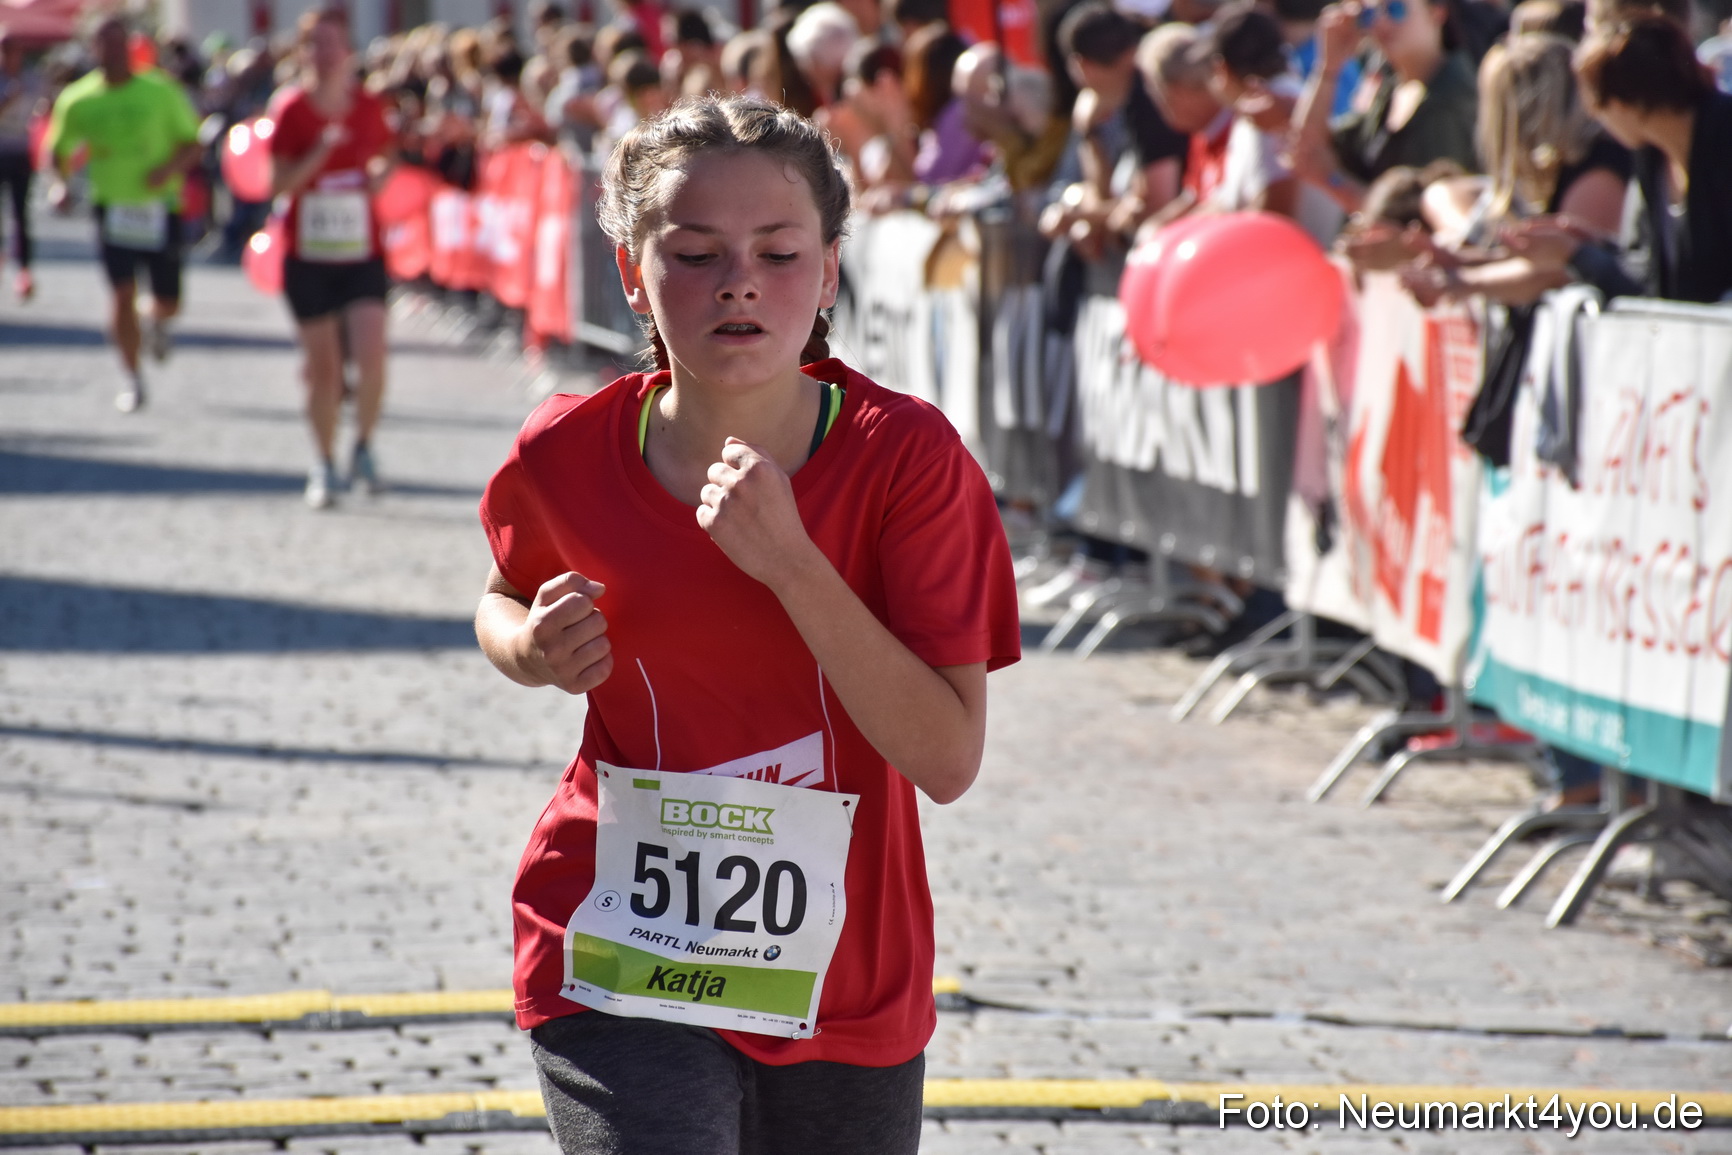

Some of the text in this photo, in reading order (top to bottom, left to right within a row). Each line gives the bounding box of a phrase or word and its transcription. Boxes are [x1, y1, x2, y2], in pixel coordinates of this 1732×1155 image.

[661, 798, 776, 835] BOCK
[661, 826, 775, 845] inspired by smart concepts
[601, 896, 613, 908] S
[630, 841, 807, 936] 5120
[629, 927, 681, 949] PARTL
[685, 941, 759, 959] Neumarkt
[646, 965, 727, 1002] Katja
